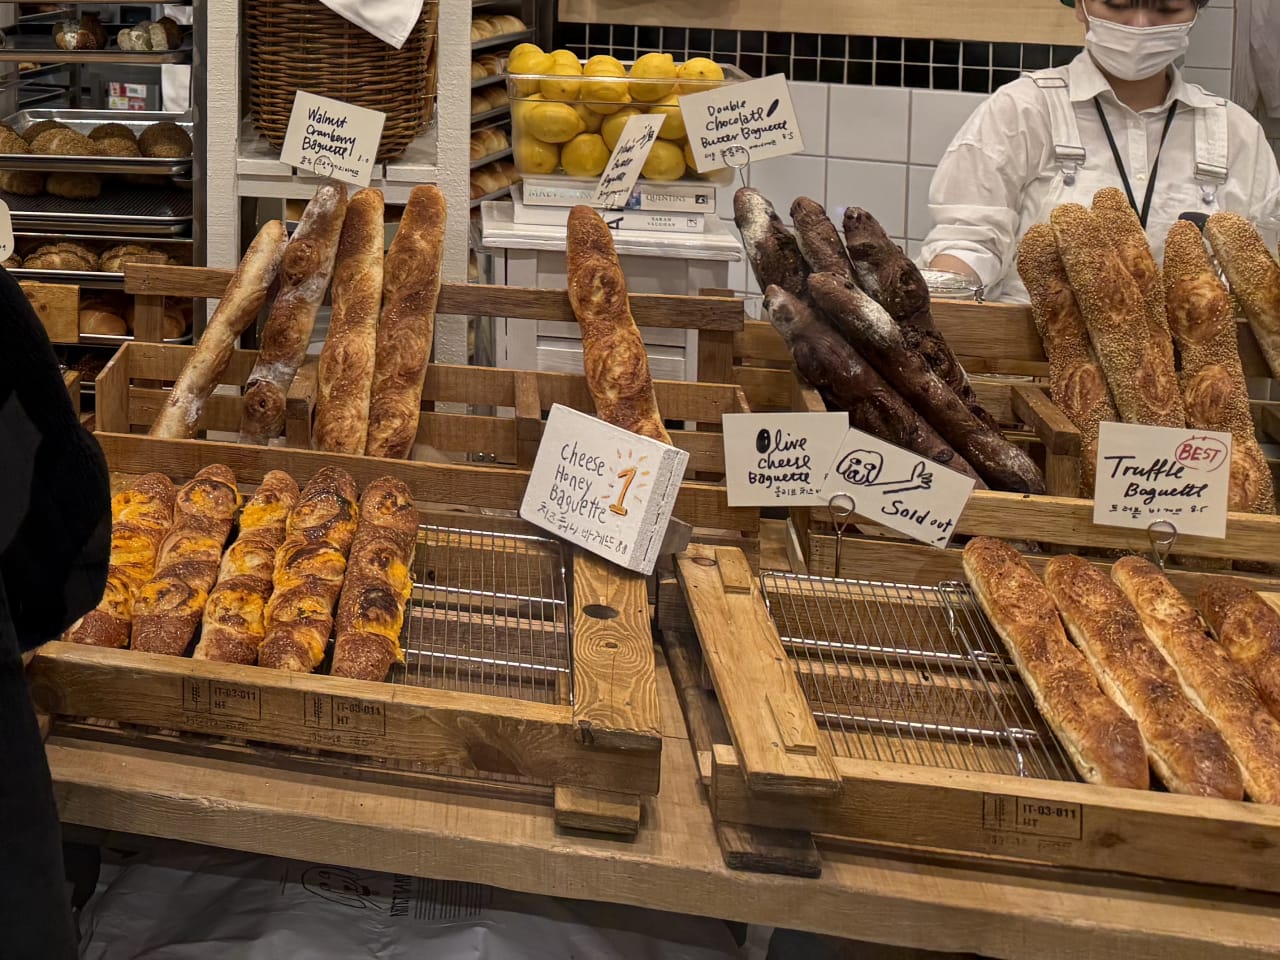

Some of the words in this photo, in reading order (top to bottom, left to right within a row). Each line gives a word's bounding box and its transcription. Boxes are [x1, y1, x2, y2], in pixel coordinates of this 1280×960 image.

[308, 106, 347, 128] Walnut
[707, 100, 746, 116] Double
[306, 124, 356, 157] Cranberry
[700, 132, 739, 149] Butter
[740, 120, 788, 140] Baguette
[302, 136, 348, 160] Baguette
[646, 194, 686, 203] QUENTINS
[756, 428, 807, 453] Olive
[1178, 443, 1221, 463] BEST
[748, 471, 810, 488] Baguette
[1104, 455, 1185, 482] Truffle
[555, 465, 592, 500] Honey
[609, 465, 638, 517] 1
[1124, 482, 1208, 505] Baguette
[550, 484, 607, 524] Baguette
[881, 500, 927, 525] Sold
[930, 518, 953, 532] out
